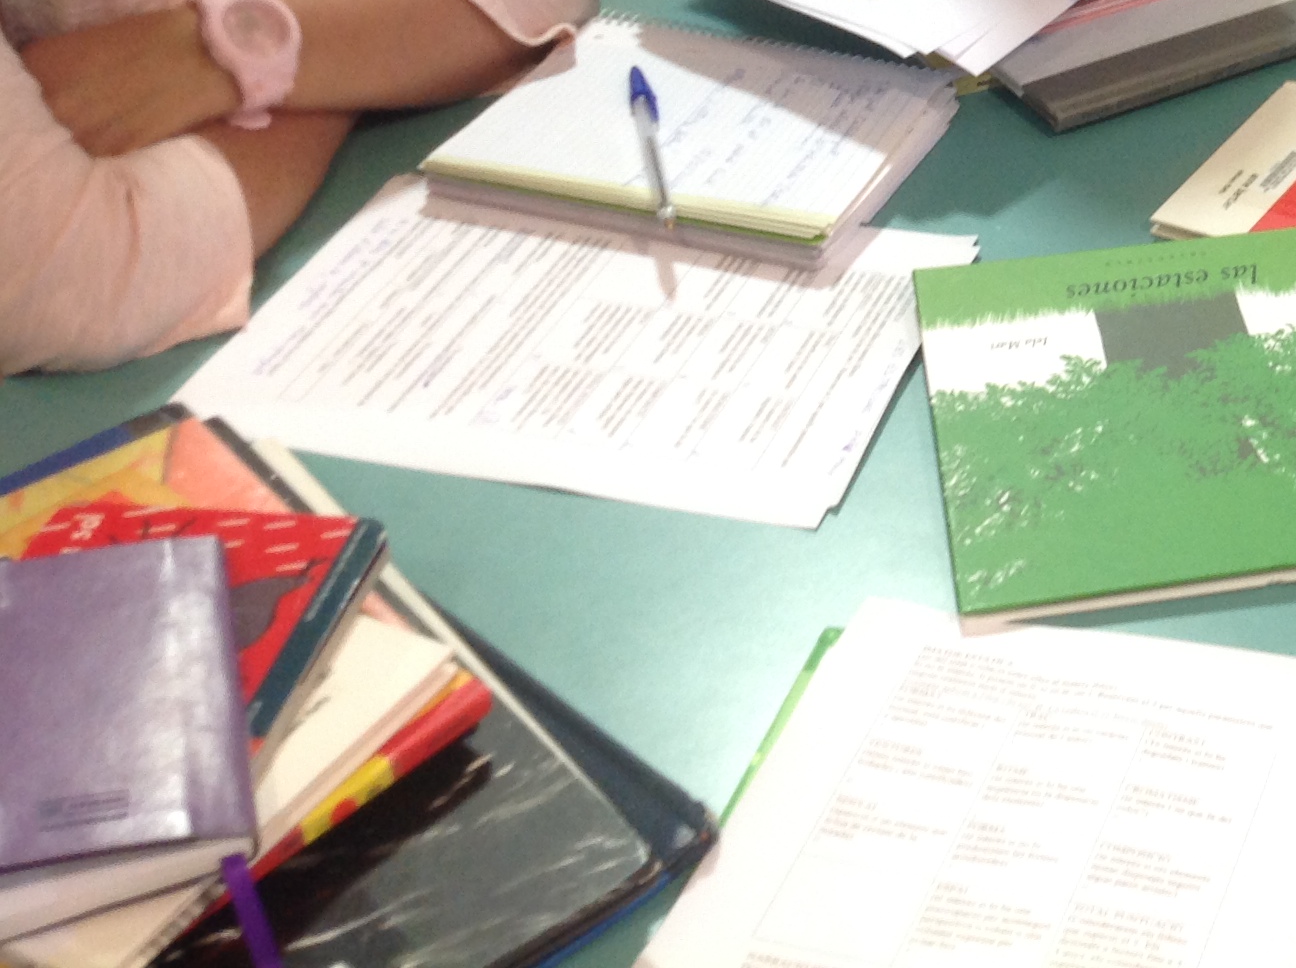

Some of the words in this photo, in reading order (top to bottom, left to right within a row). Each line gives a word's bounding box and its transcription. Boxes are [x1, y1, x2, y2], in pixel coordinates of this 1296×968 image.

[1066, 270, 1208, 299] estaciones
[1221, 264, 1257, 285] las
[990, 336, 1021, 351] Mari
